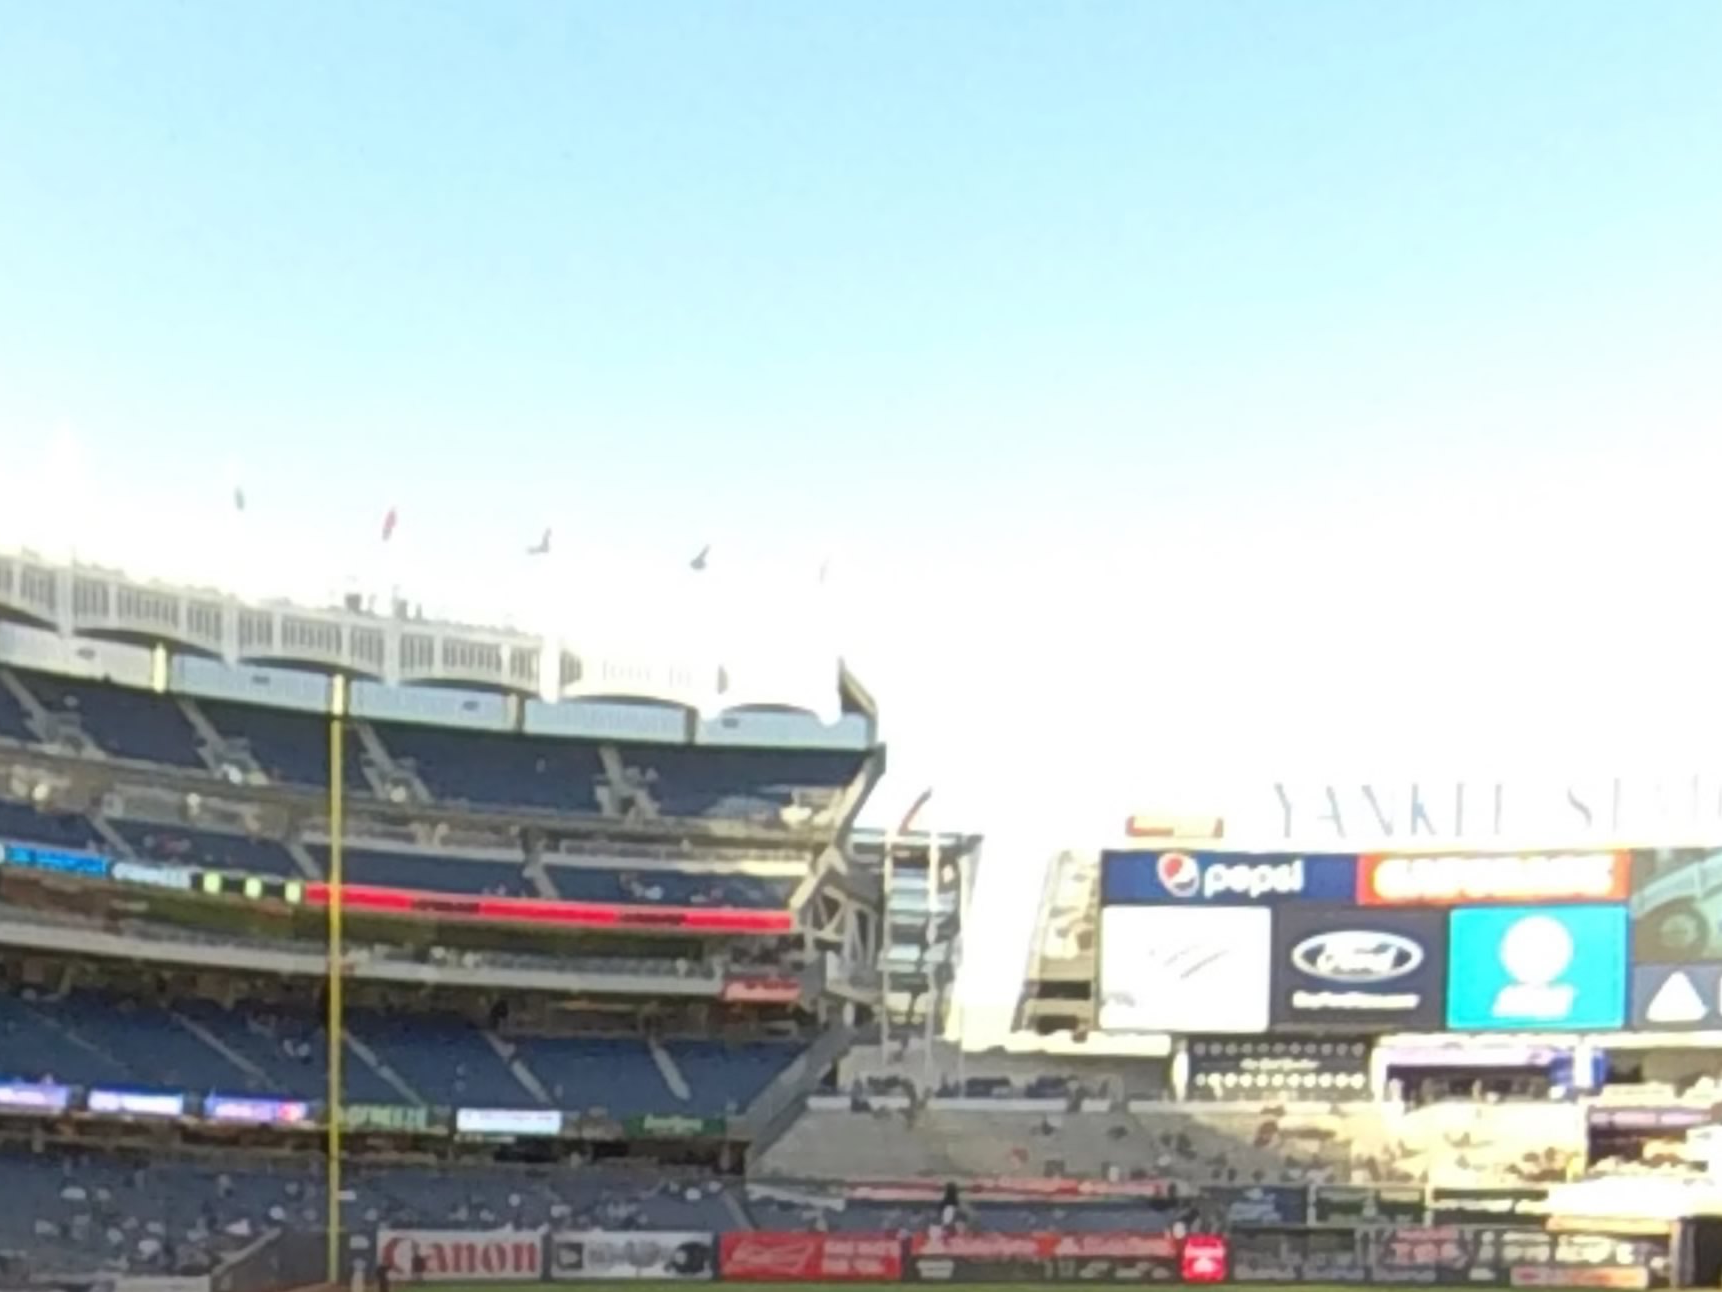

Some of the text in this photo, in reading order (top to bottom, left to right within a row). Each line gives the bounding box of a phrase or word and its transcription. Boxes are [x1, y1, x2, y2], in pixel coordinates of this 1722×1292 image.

[1204, 858, 1306, 898] pepsi
[1315, 941, 1397, 976] Ford
[381, 1236, 539, 1275] Canon
